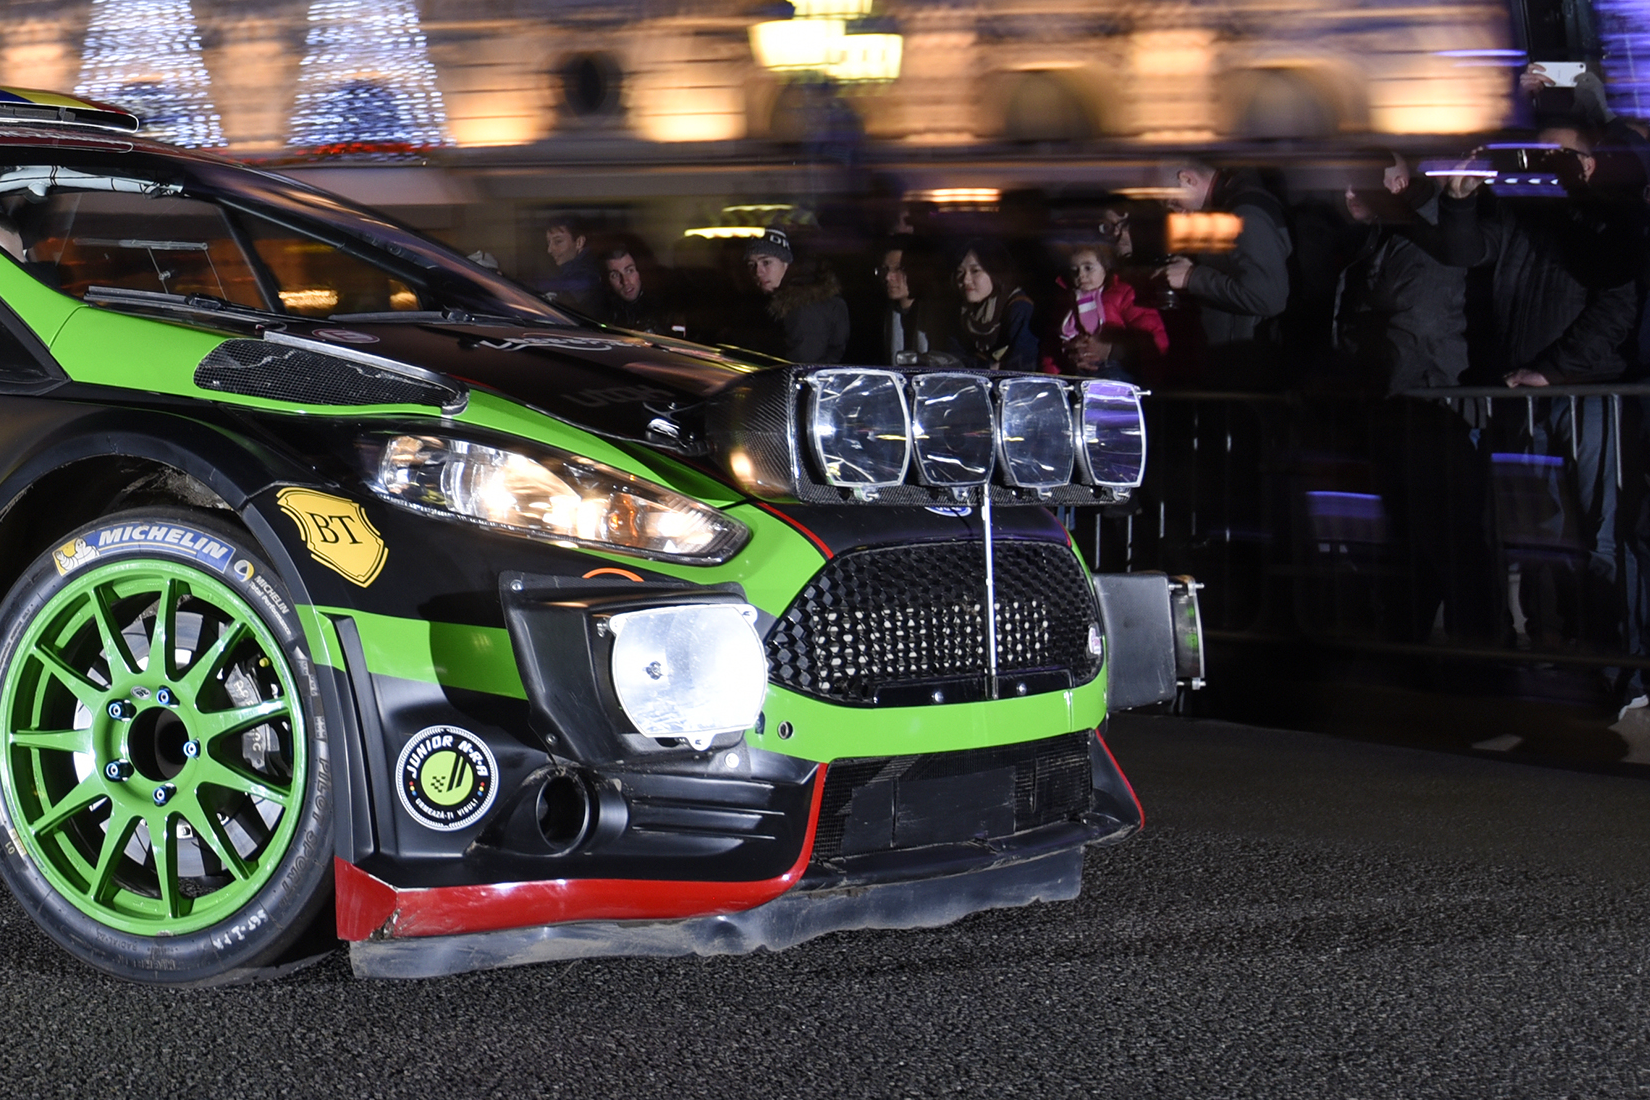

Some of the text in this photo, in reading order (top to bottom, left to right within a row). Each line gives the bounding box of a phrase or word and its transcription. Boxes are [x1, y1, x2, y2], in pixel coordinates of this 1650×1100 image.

[99, 525, 229, 560] MICHELIN
[304, 510, 364, 545] BT
[249, 580, 264, 597] Total
[254, 575, 290, 614] MICHELIN
[406, 735, 453, 779] JUNIOR
[281, 757, 331, 892] PILOT SPORT
